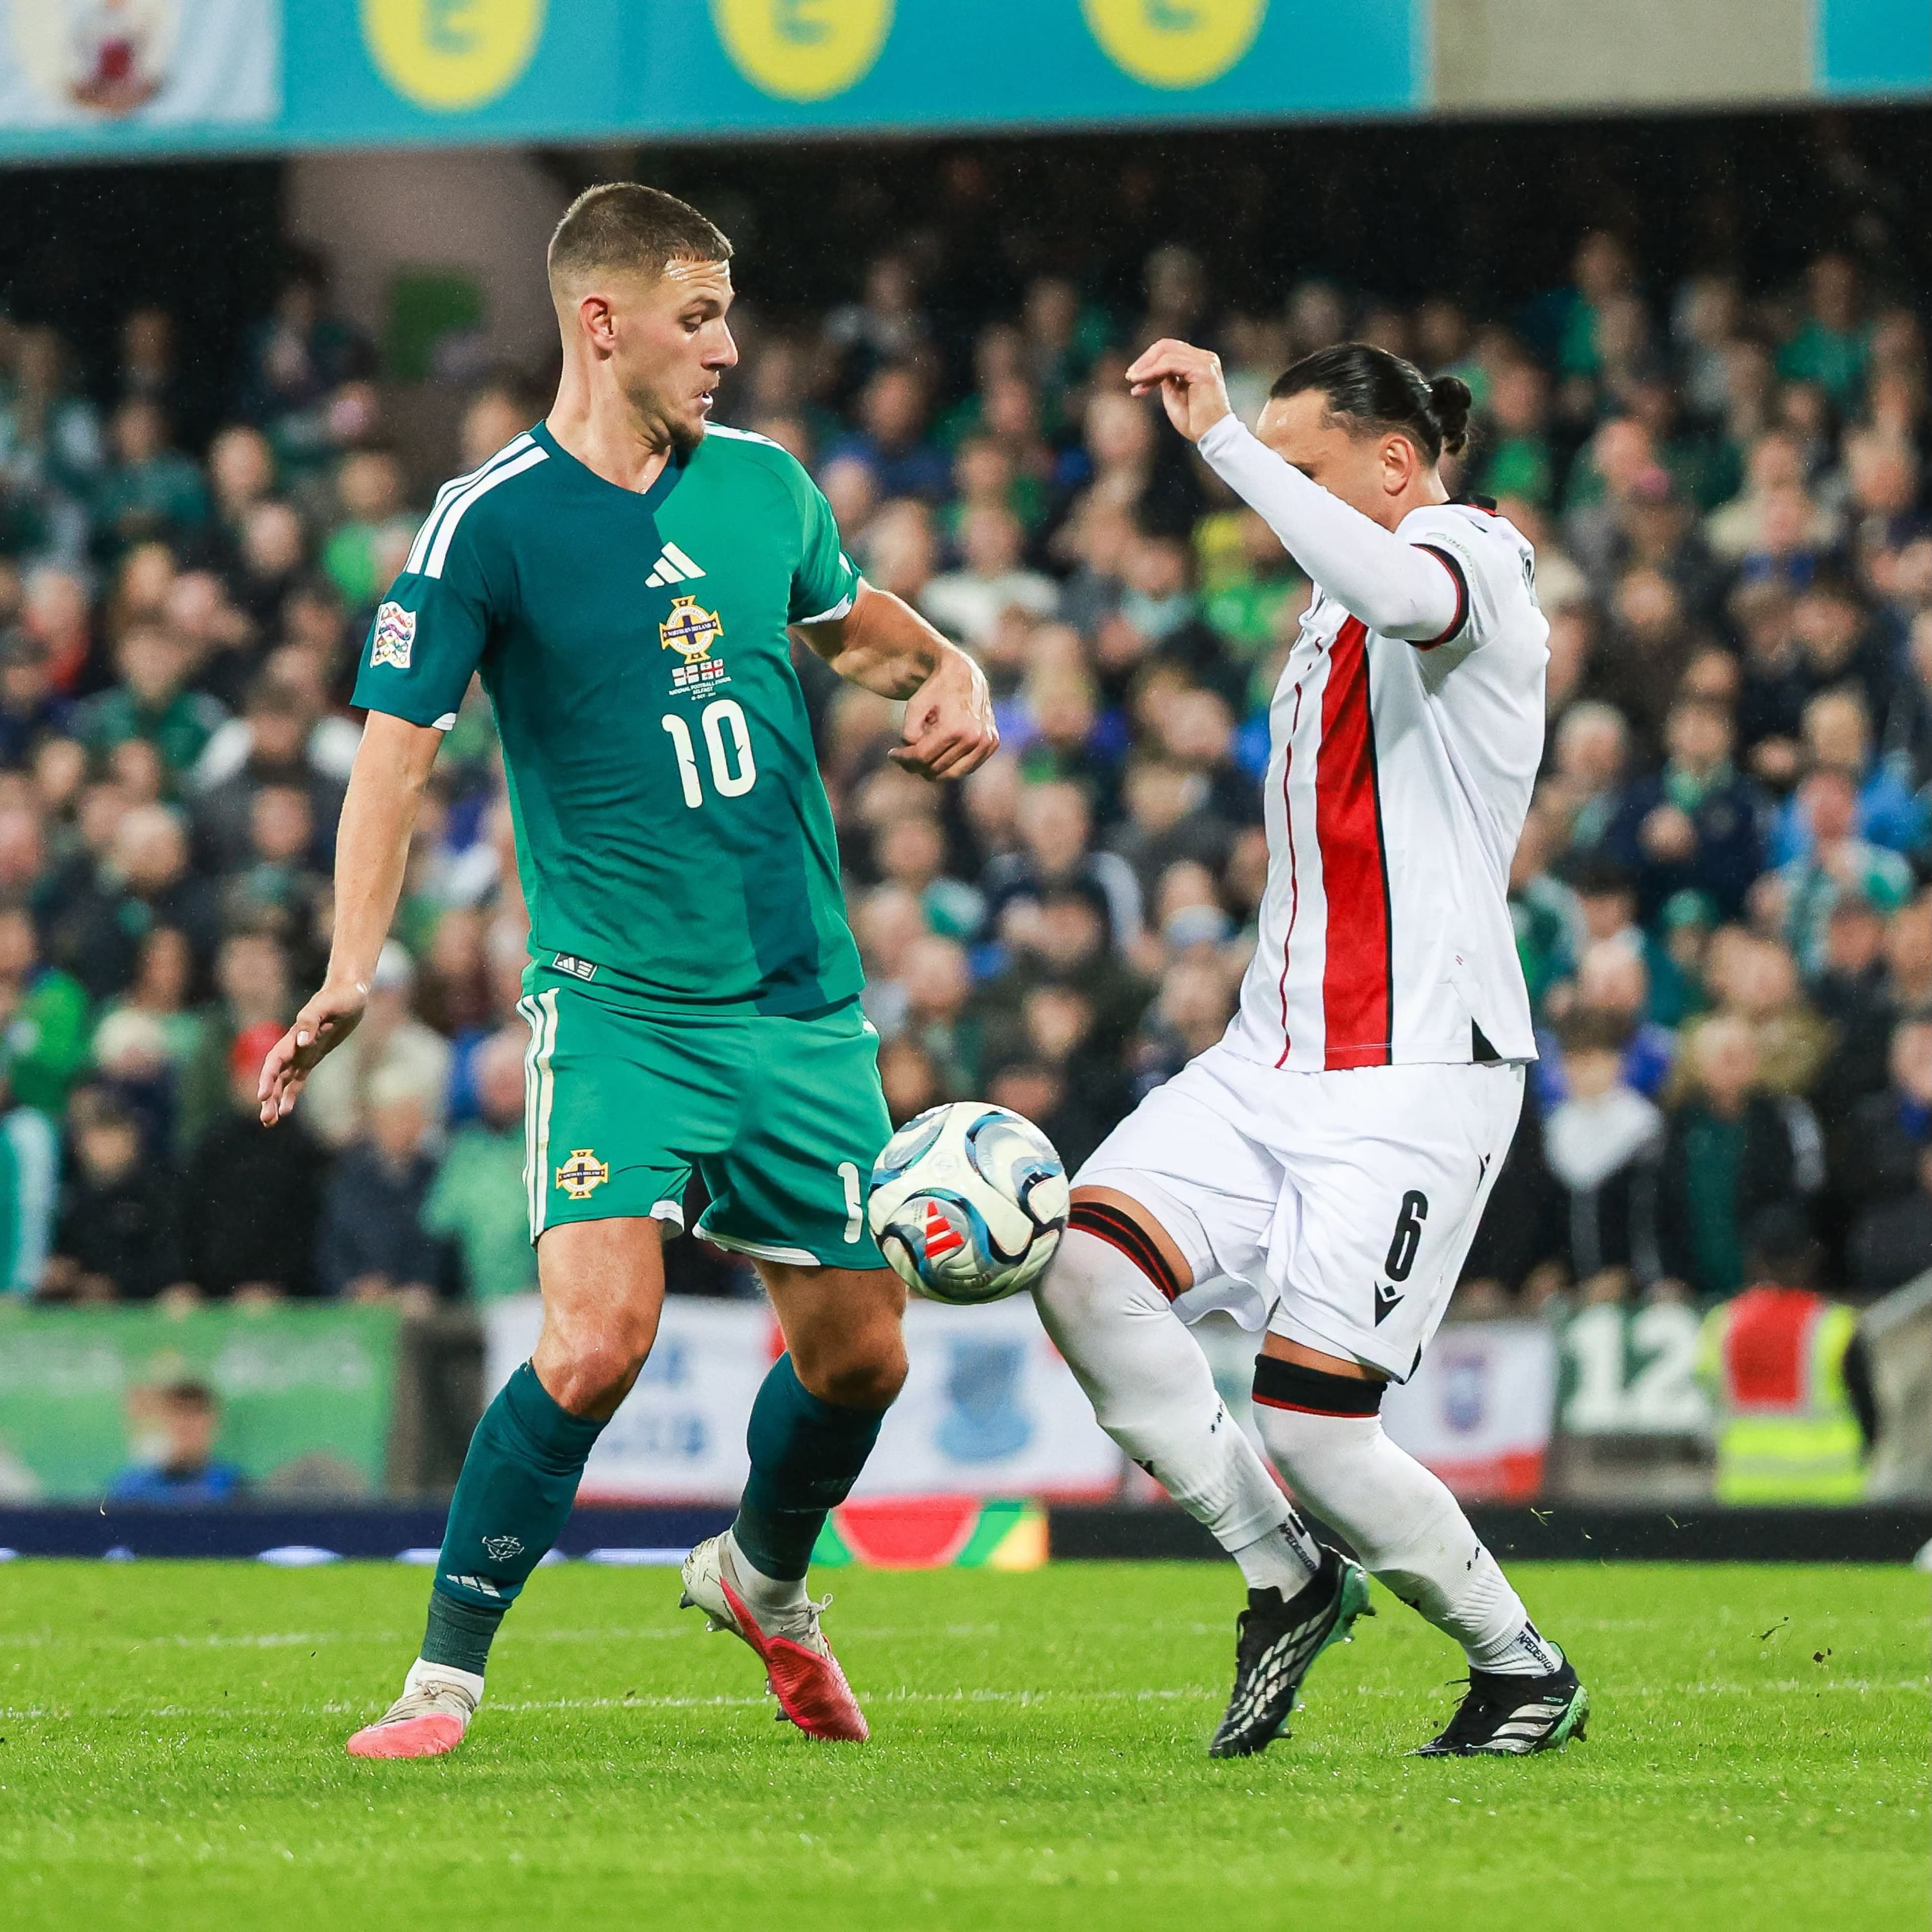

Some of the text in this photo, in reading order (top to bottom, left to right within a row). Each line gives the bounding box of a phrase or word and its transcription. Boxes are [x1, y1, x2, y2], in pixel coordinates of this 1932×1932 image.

[662, 699, 756, 809] 10
[1385, 1190, 1428, 1281] 6
[1561, 1302, 1708, 1430] 12
